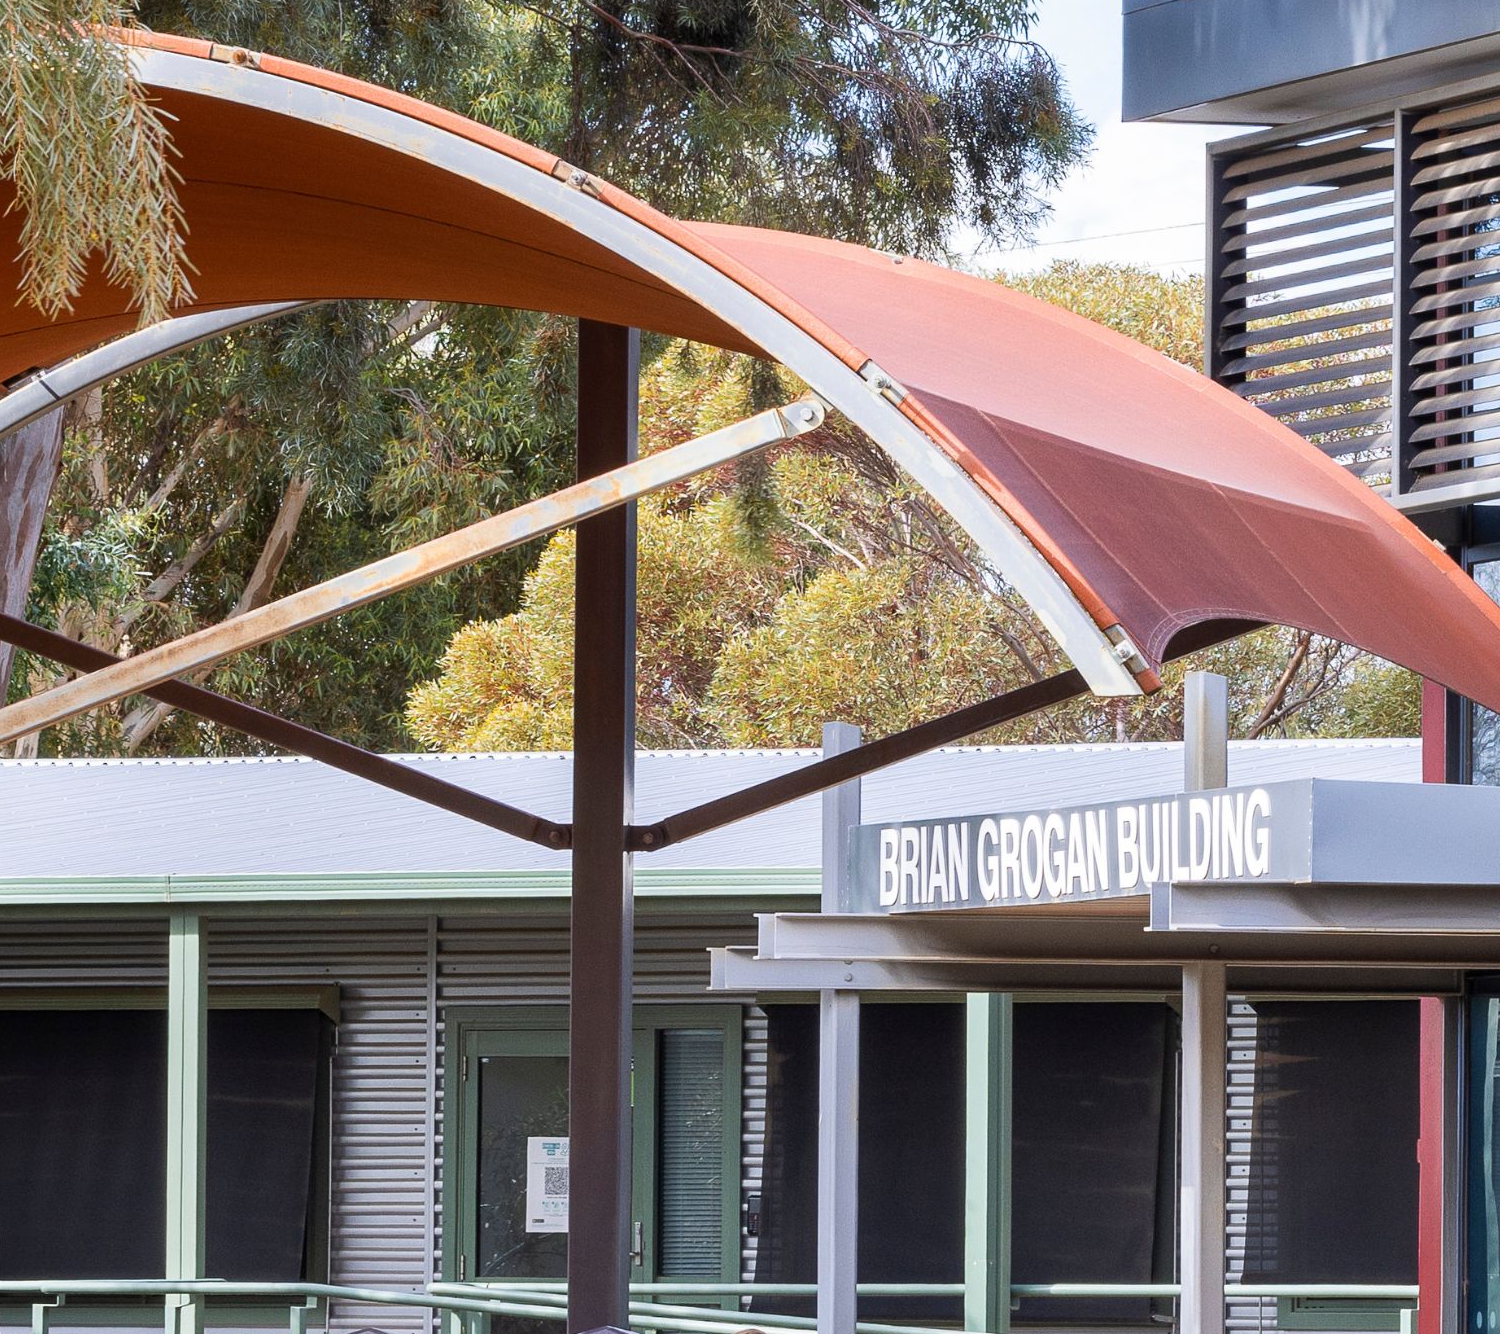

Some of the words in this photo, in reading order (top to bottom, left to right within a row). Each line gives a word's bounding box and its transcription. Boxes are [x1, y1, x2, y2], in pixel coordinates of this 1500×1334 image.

[879, 821, 970, 907] BRIAN
[976, 809, 1109, 901] GROGAN
[1116, 788, 1271, 889] BUILDING
